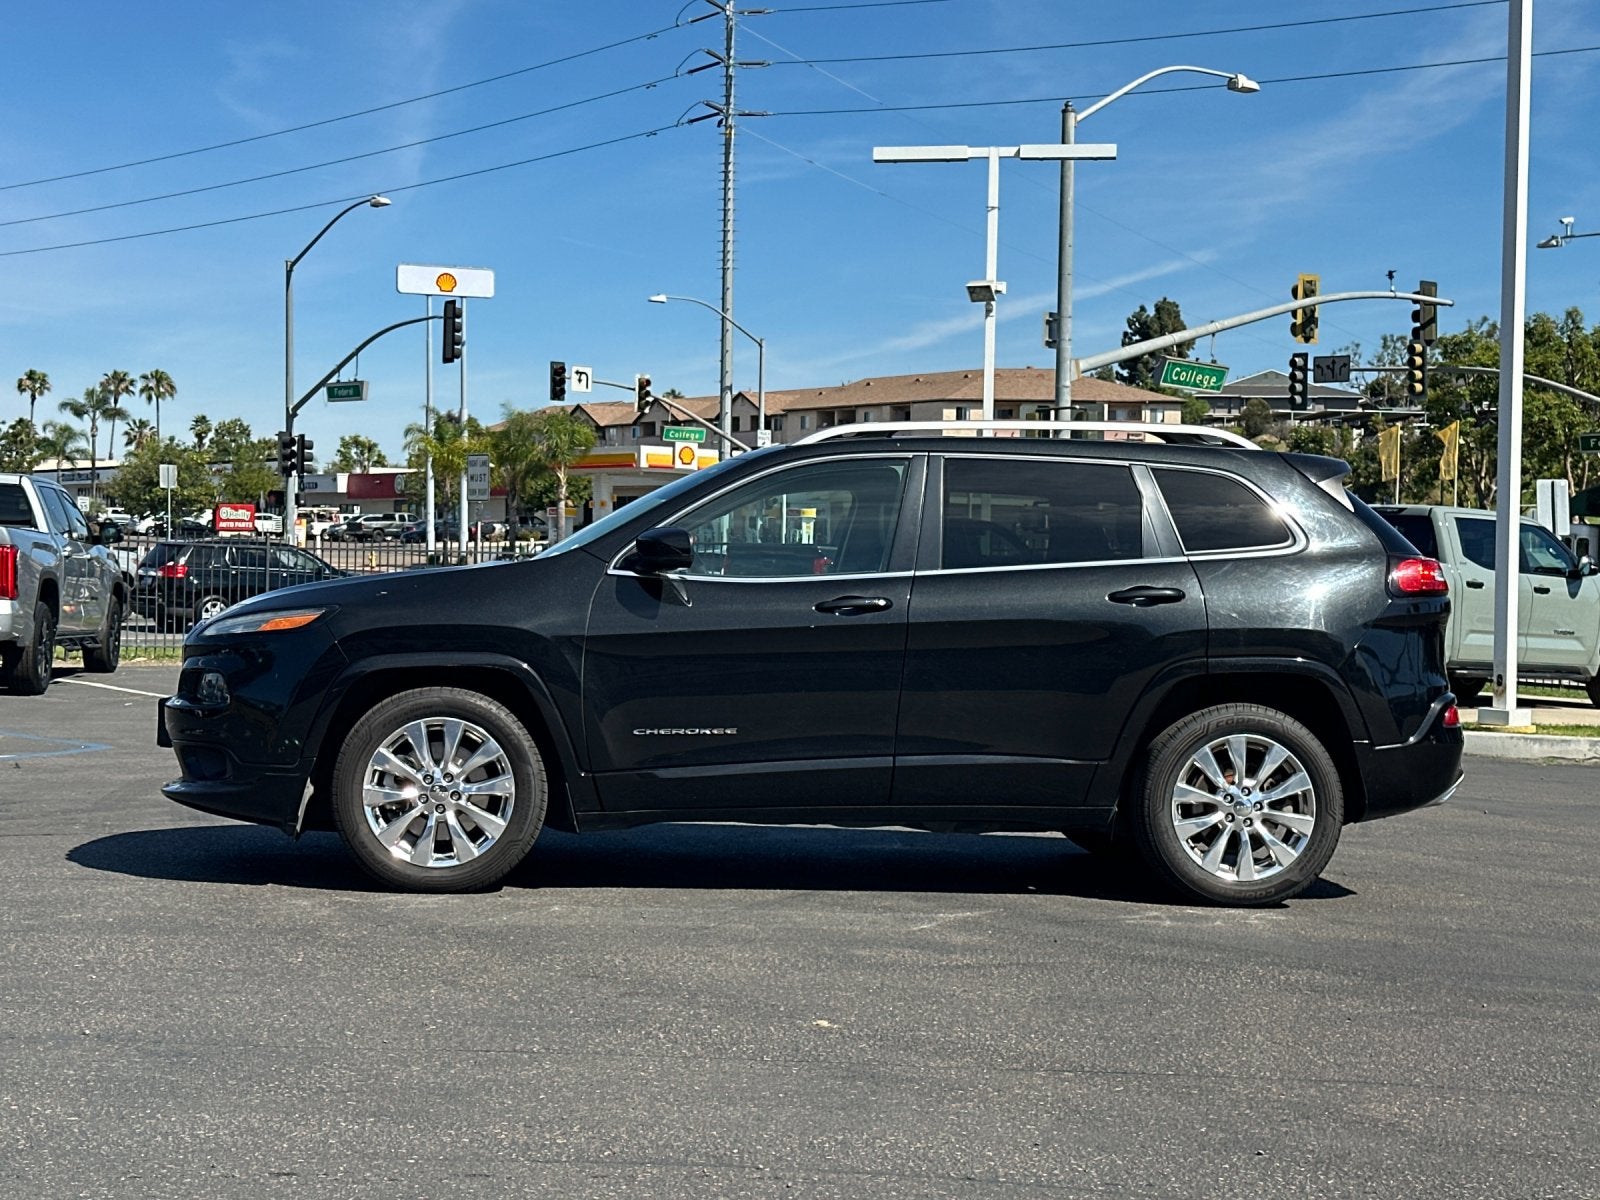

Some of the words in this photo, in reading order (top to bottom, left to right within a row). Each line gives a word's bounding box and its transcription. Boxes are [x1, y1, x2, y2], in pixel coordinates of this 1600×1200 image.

[1172, 367, 1217, 389] College
[669, 430, 699, 440] College
[470, 473, 487, 482] MUST
[633, 727, 738, 735] CHEROKEE
